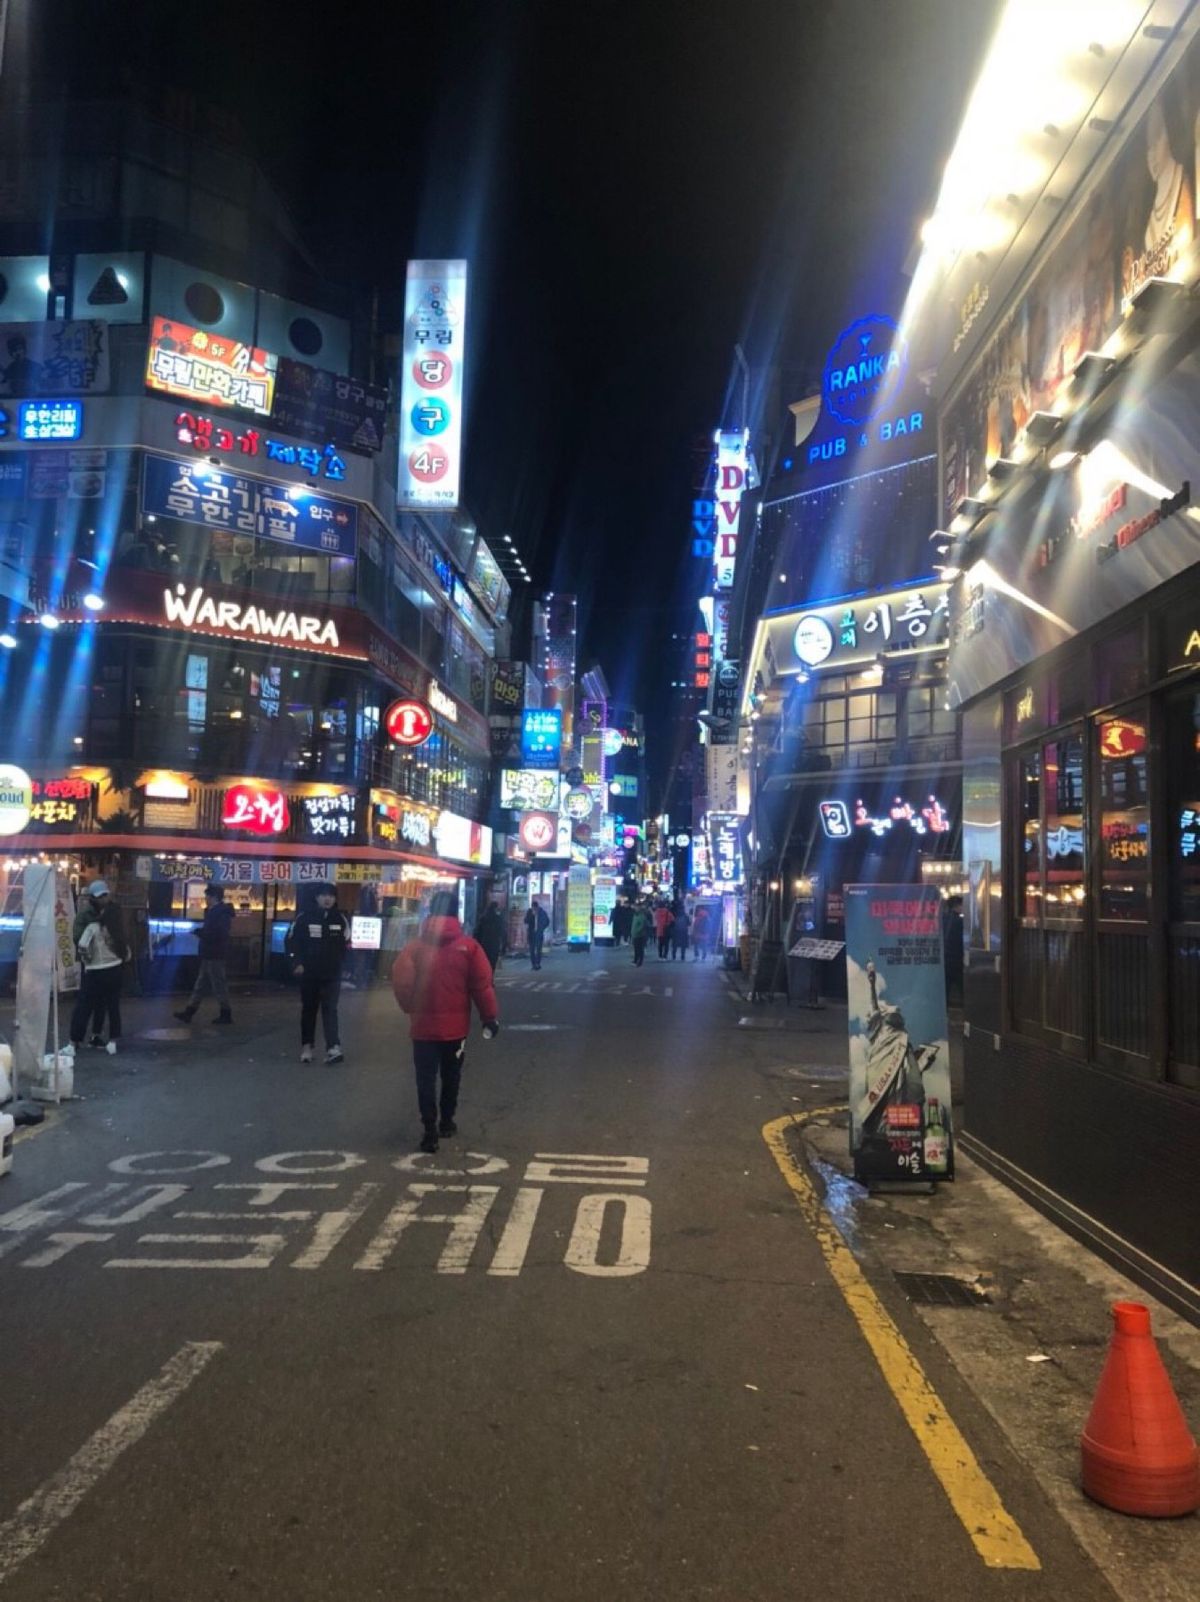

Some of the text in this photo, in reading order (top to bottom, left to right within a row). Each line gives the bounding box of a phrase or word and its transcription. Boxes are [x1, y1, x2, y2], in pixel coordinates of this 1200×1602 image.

[414, 329, 453, 345] 무림
[808, 438, 847, 464] PUB
[880, 413, 923, 441] BAR
[414, 452, 444, 474] 4F
[166, 494, 297, 541] 무한리필
[310, 505, 334, 521] 입구
[720, 466, 743, 558] DVD
[164, 584, 339, 647] WARAWARA
[864, 592, 950, 640] 이층
[220, 862, 253, 881] 겨울
[260, 862, 292, 881] 방어
[298, 862, 329, 880] 잔치
